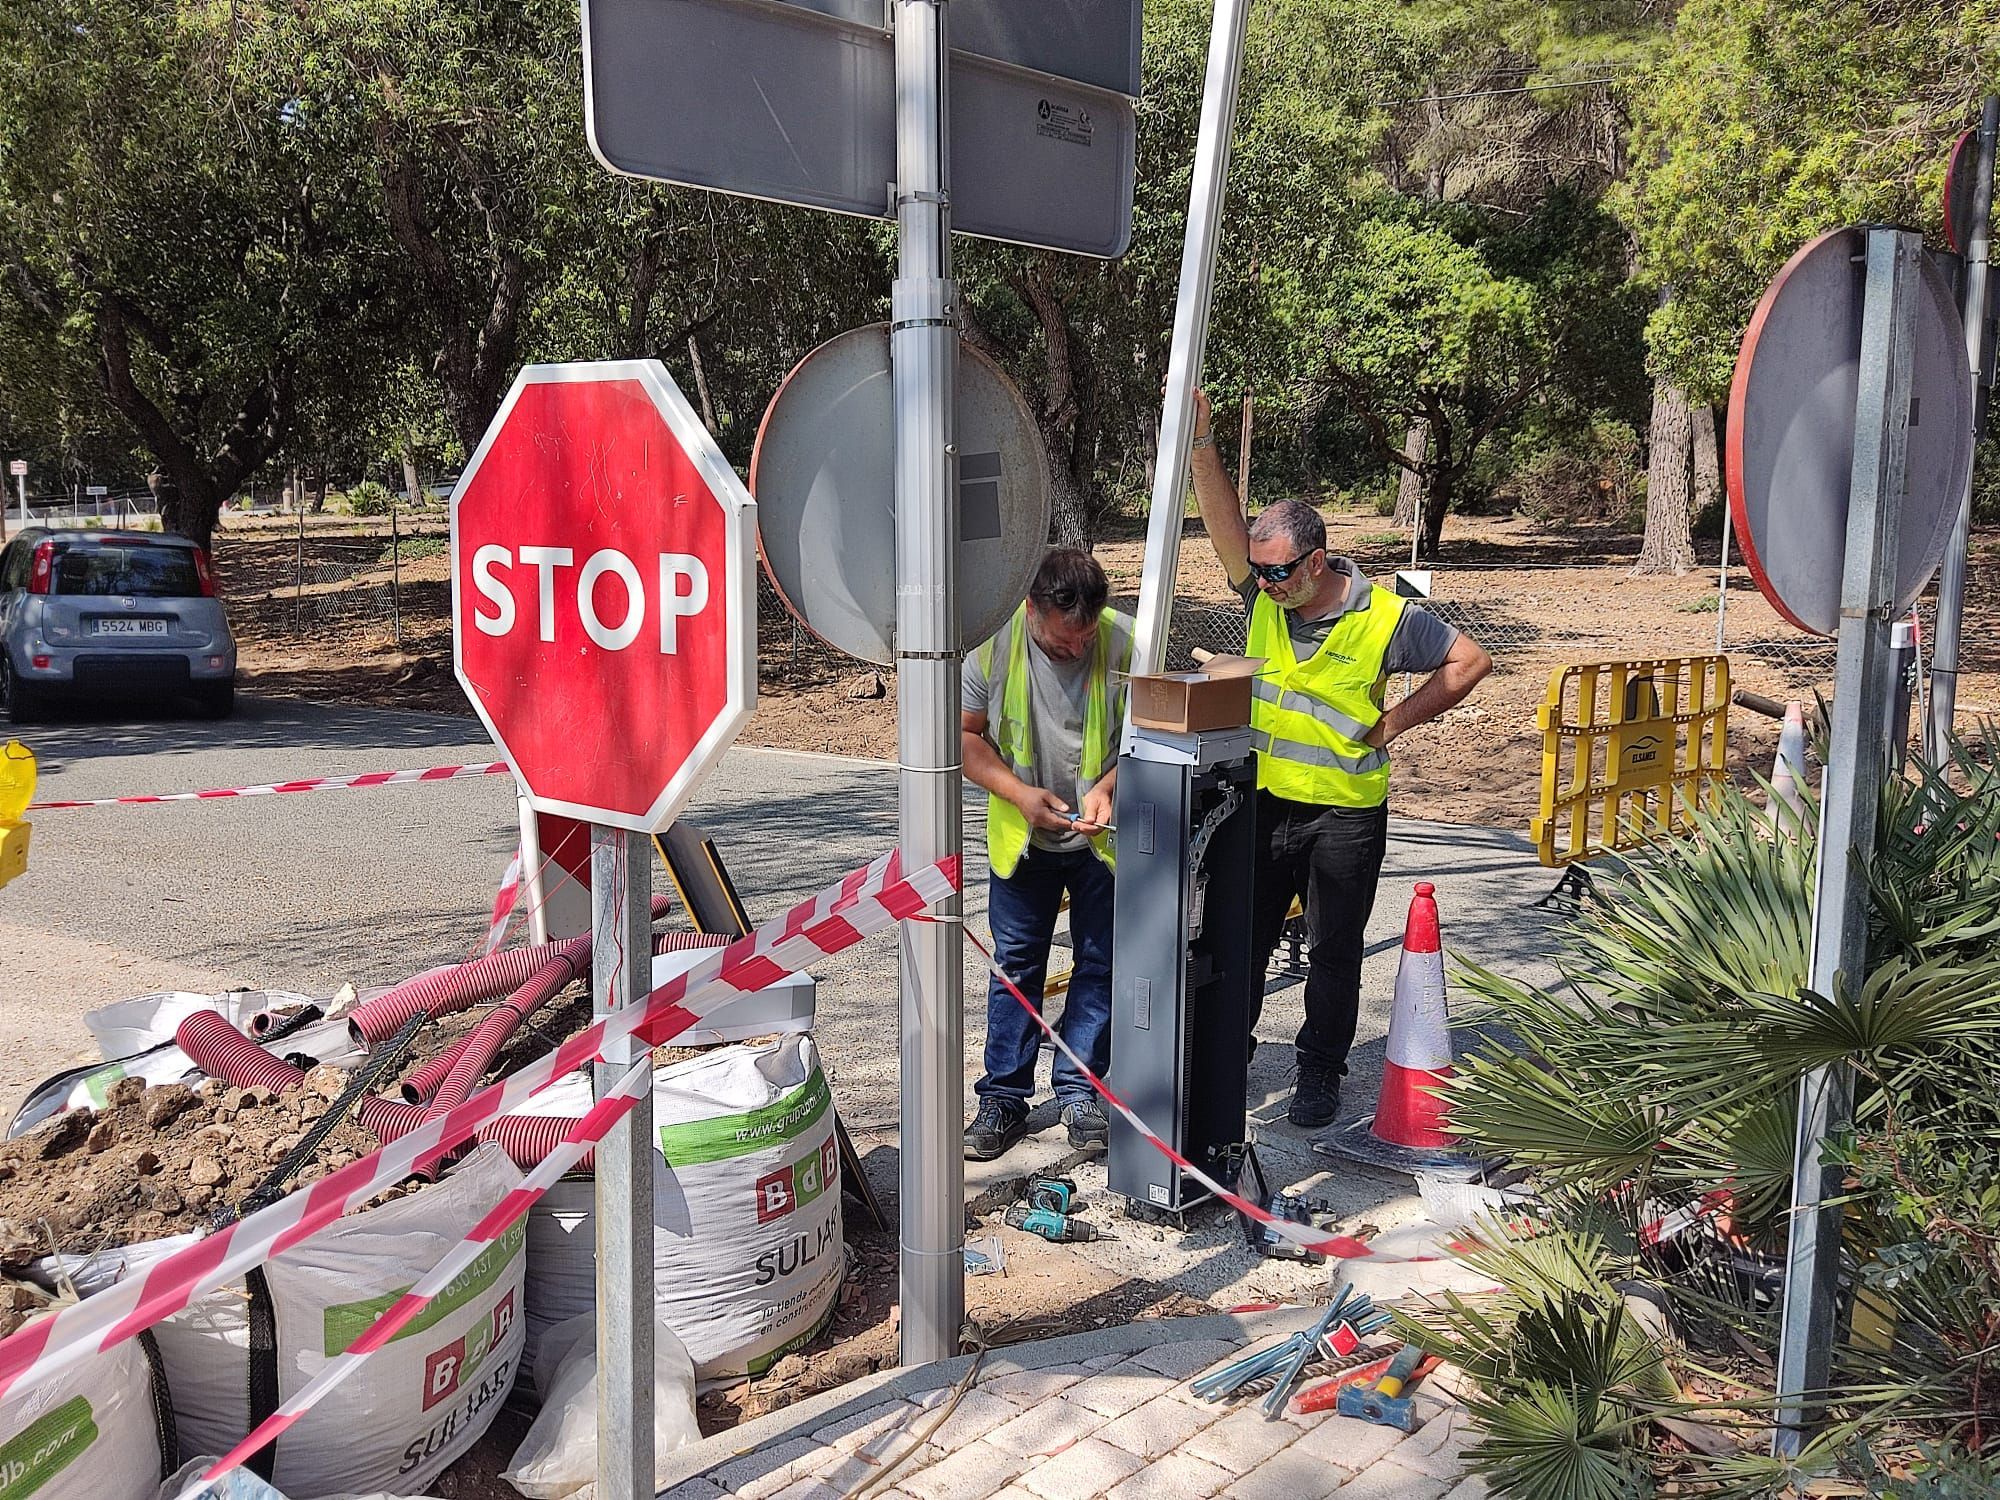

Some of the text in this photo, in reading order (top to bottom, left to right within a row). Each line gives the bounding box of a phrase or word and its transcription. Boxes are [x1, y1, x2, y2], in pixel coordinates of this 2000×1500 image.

[472, 544, 709, 655] STOP
[102, 620, 163, 632] 5524 MBG
[1631, 750, 1657, 764] ELSAMEX
[764, 1143, 836, 1214] BdB
[446, 1252, 492, 1297] 630 437
[432, 1303, 511, 1396] BdB
[760, 1324, 774, 1335] en
